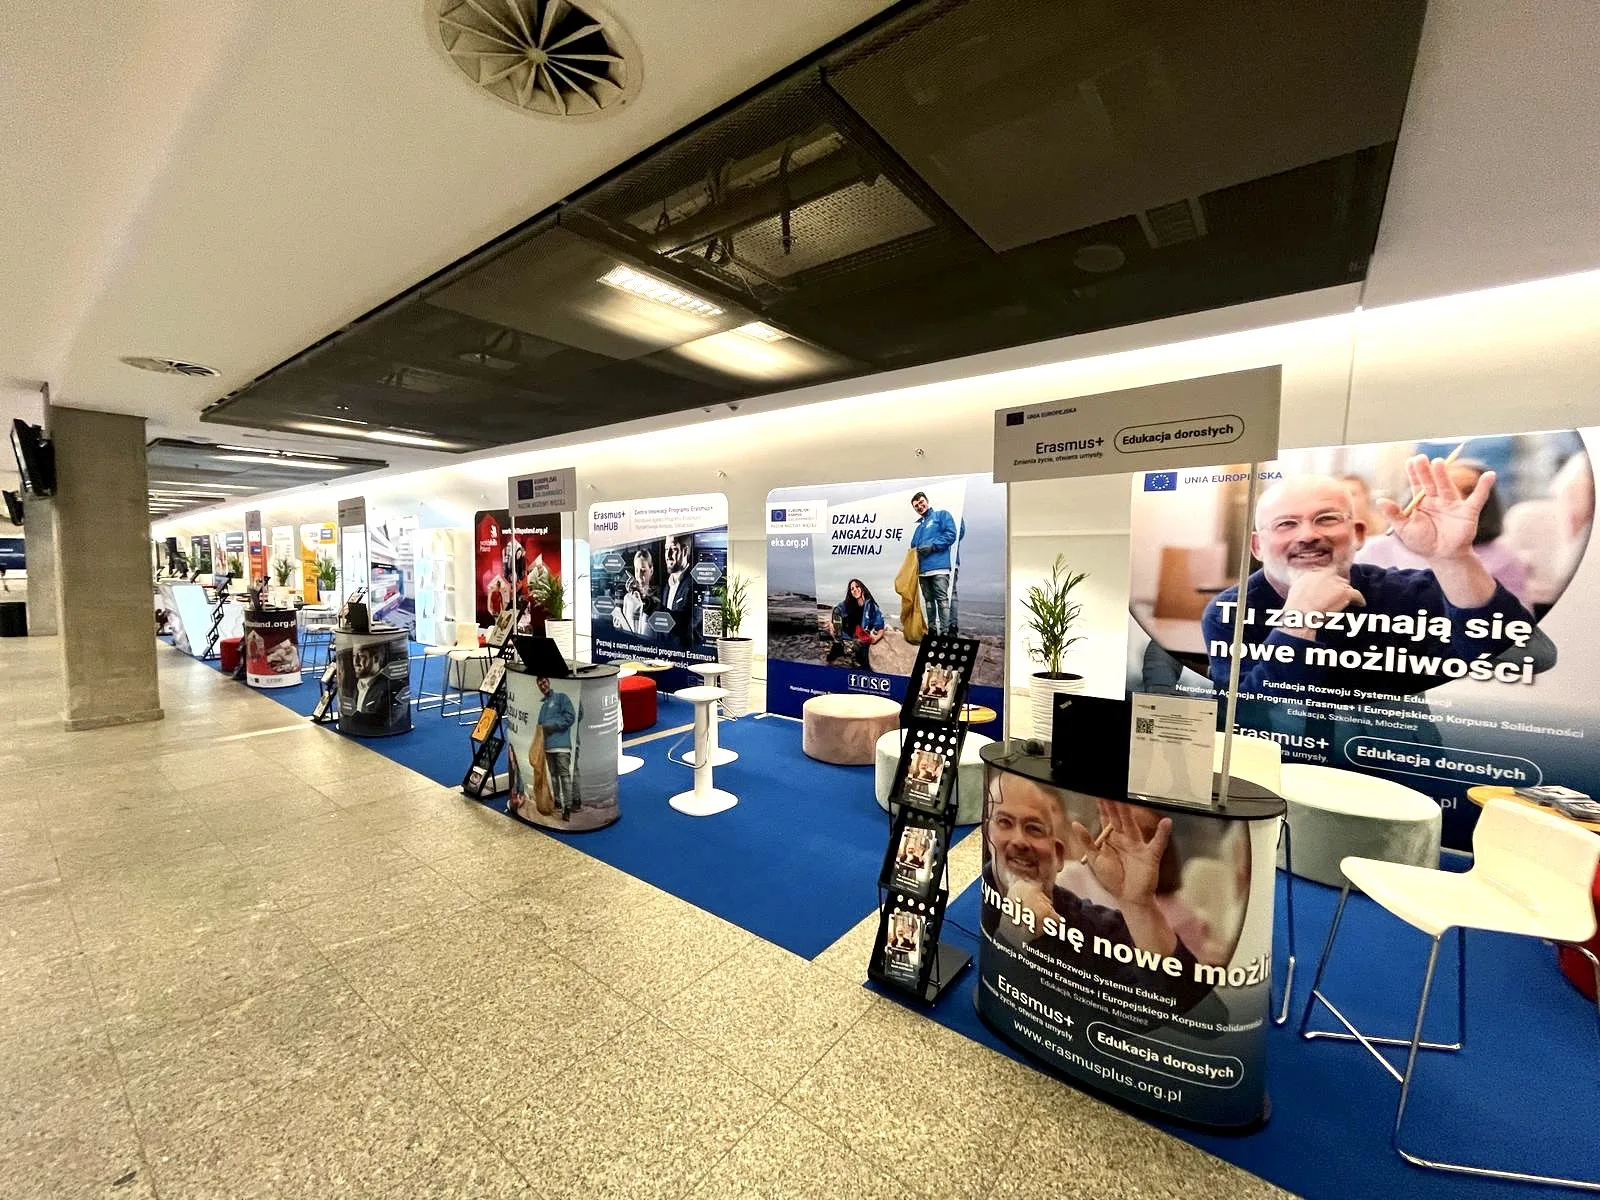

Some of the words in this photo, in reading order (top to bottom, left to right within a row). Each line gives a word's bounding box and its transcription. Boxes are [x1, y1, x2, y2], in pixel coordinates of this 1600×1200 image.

[1036, 437, 1104, 454] Erasmus+
[1122, 432, 1171, 445] Edukacja
[1174, 424, 1234, 440] dorosłych
[1184, 475, 1209, 484] UNIA
[1212, 471, 1283, 483] EUROPJSKA
[594, 511, 626, 520] Erasmus+
[832, 513, 877, 525] DZIAŁAJ
[771, 537, 809, 548] eks.org.pl
[832, 527, 882, 540] ANGAŻUJ
[885, 528, 903, 541] SIĘ
[832, 545, 882, 555] ZMIENIAJ
[1216, 602, 1255, 625] Tu
[1265, 609, 1452, 643] zaczynają
[1464, 612, 1533, 647] się
[686, 651, 716, 661] Erasmus+
[1210, 640, 1295, 663] nowe
[1305, 645, 1535, 685] możliwości
[851, 674, 889, 691] frse
[1262, 680, 1306, 692] Fundacja
[1308, 684, 1351, 697] Rozwoju
[1353, 688, 1401, 702] Systemu
[1175, 684, 1217, 696] Narodowa
[1219, 689, 1255, 701] Agncja
[1257, 694, 1303, 706] Programu
[1306, 699, 1355, 712] Erasmus+
[1364, 705, 1443, 723] Europejskiego
[1446, 714, 1498, 729] Korpusu
[1501, 720, 1584, 738] Solidarności
[1287, 708, 1327, 720] Edukacja,
[1329, 714, 1373, 727] Szkolenia,
[1233, 723, 1329, 750] Erasmus+
[1357, 745, 1430, 767] Edukacja
[1436, 757, 1526, 781] dorosłych
[1043, 916, 1085, 953] się
[1094, 935, 1183, 977] nowe
[1022, 941, 1055, 964] Fundacja
[1056, 958, 1091, 980] Rozwoju
[1094, 974, 1134, 994] Systemu
[1135, 988, 1177, 1007] Edukacji
[998, 974, 1074, 1027] Erasmus+
[1018, 953, 1053, 977] Programu
[1055, 973, 1095, 995] Erasmus+
[1102, 992, 1169, 1020] Europejskiego
[1172, 1013, 1213, 1031] Korpusu
[1013, 1019, 1182, 1103] www.erasmusplus.org.pl
[1097, 1031, 1160, 1062] Edukacja
[1163, 1054, 1234, 1079] dorosłych
